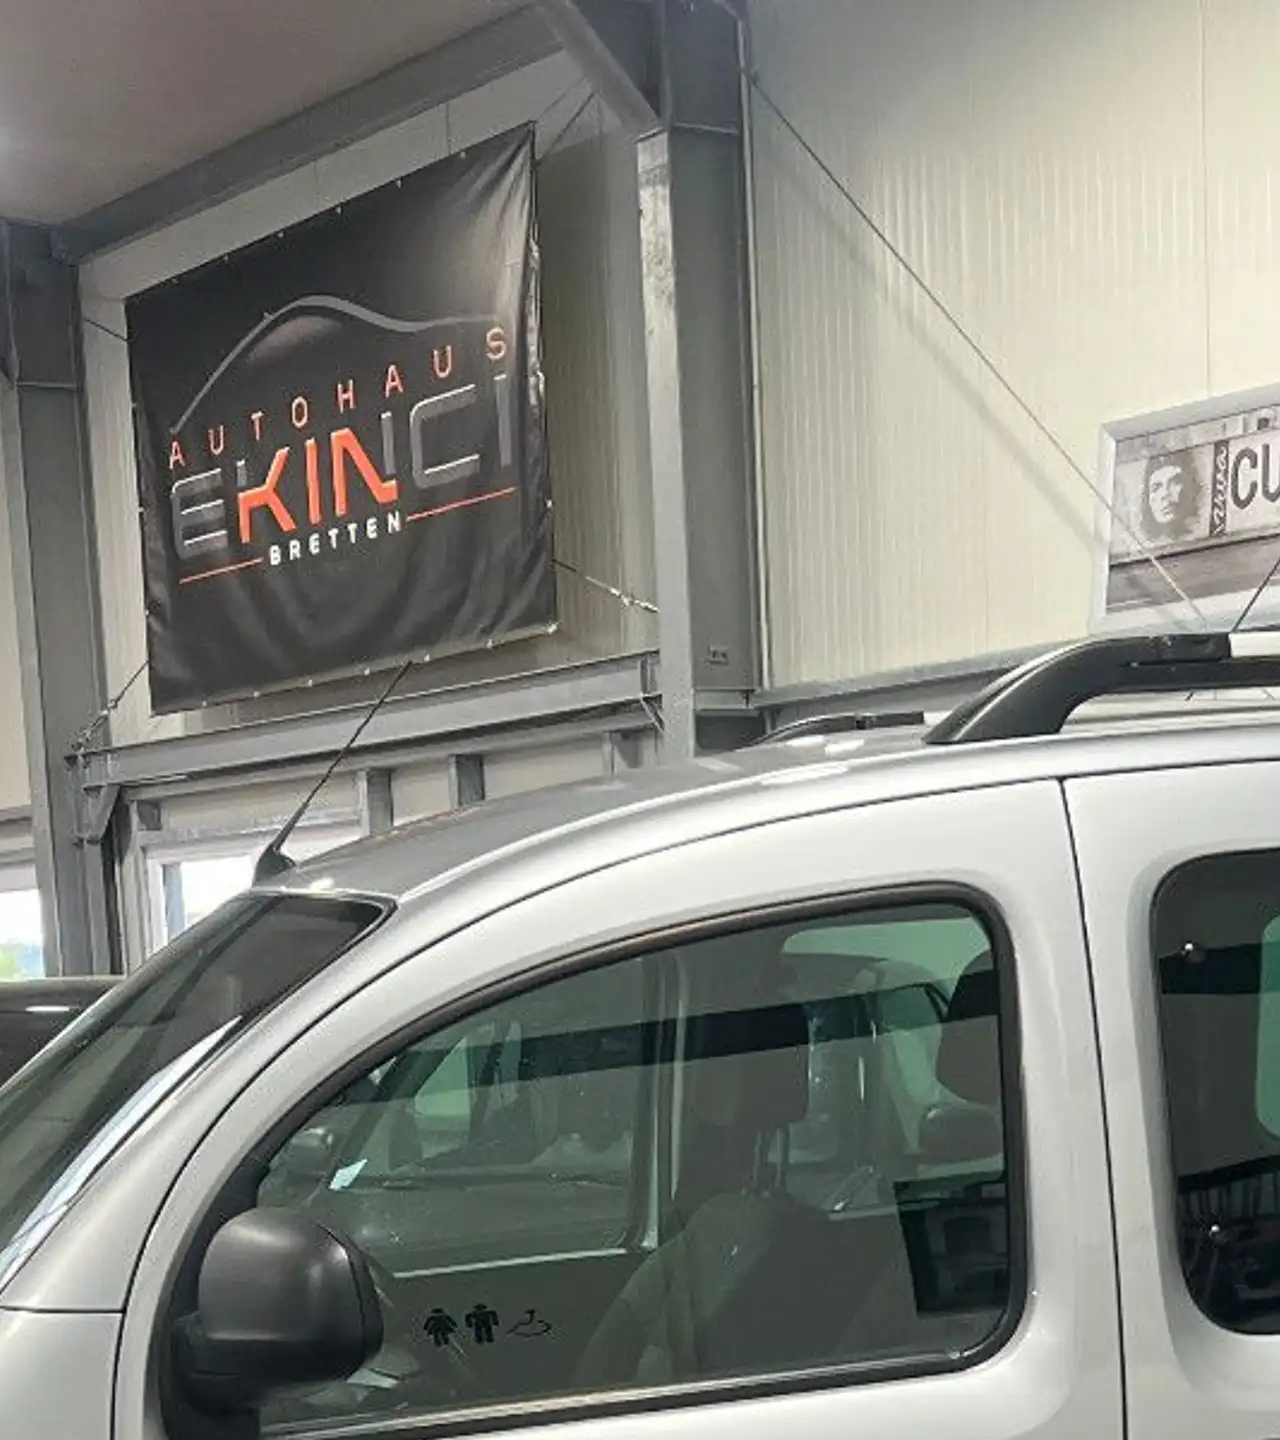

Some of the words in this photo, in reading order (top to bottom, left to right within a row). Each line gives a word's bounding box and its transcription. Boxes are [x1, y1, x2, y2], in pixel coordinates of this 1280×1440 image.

[168, 327, 508, 469] AUTOHAUS
[170, 374, 510, 559] EKINCI
[269, 511, 403, 566] BRETTEN
